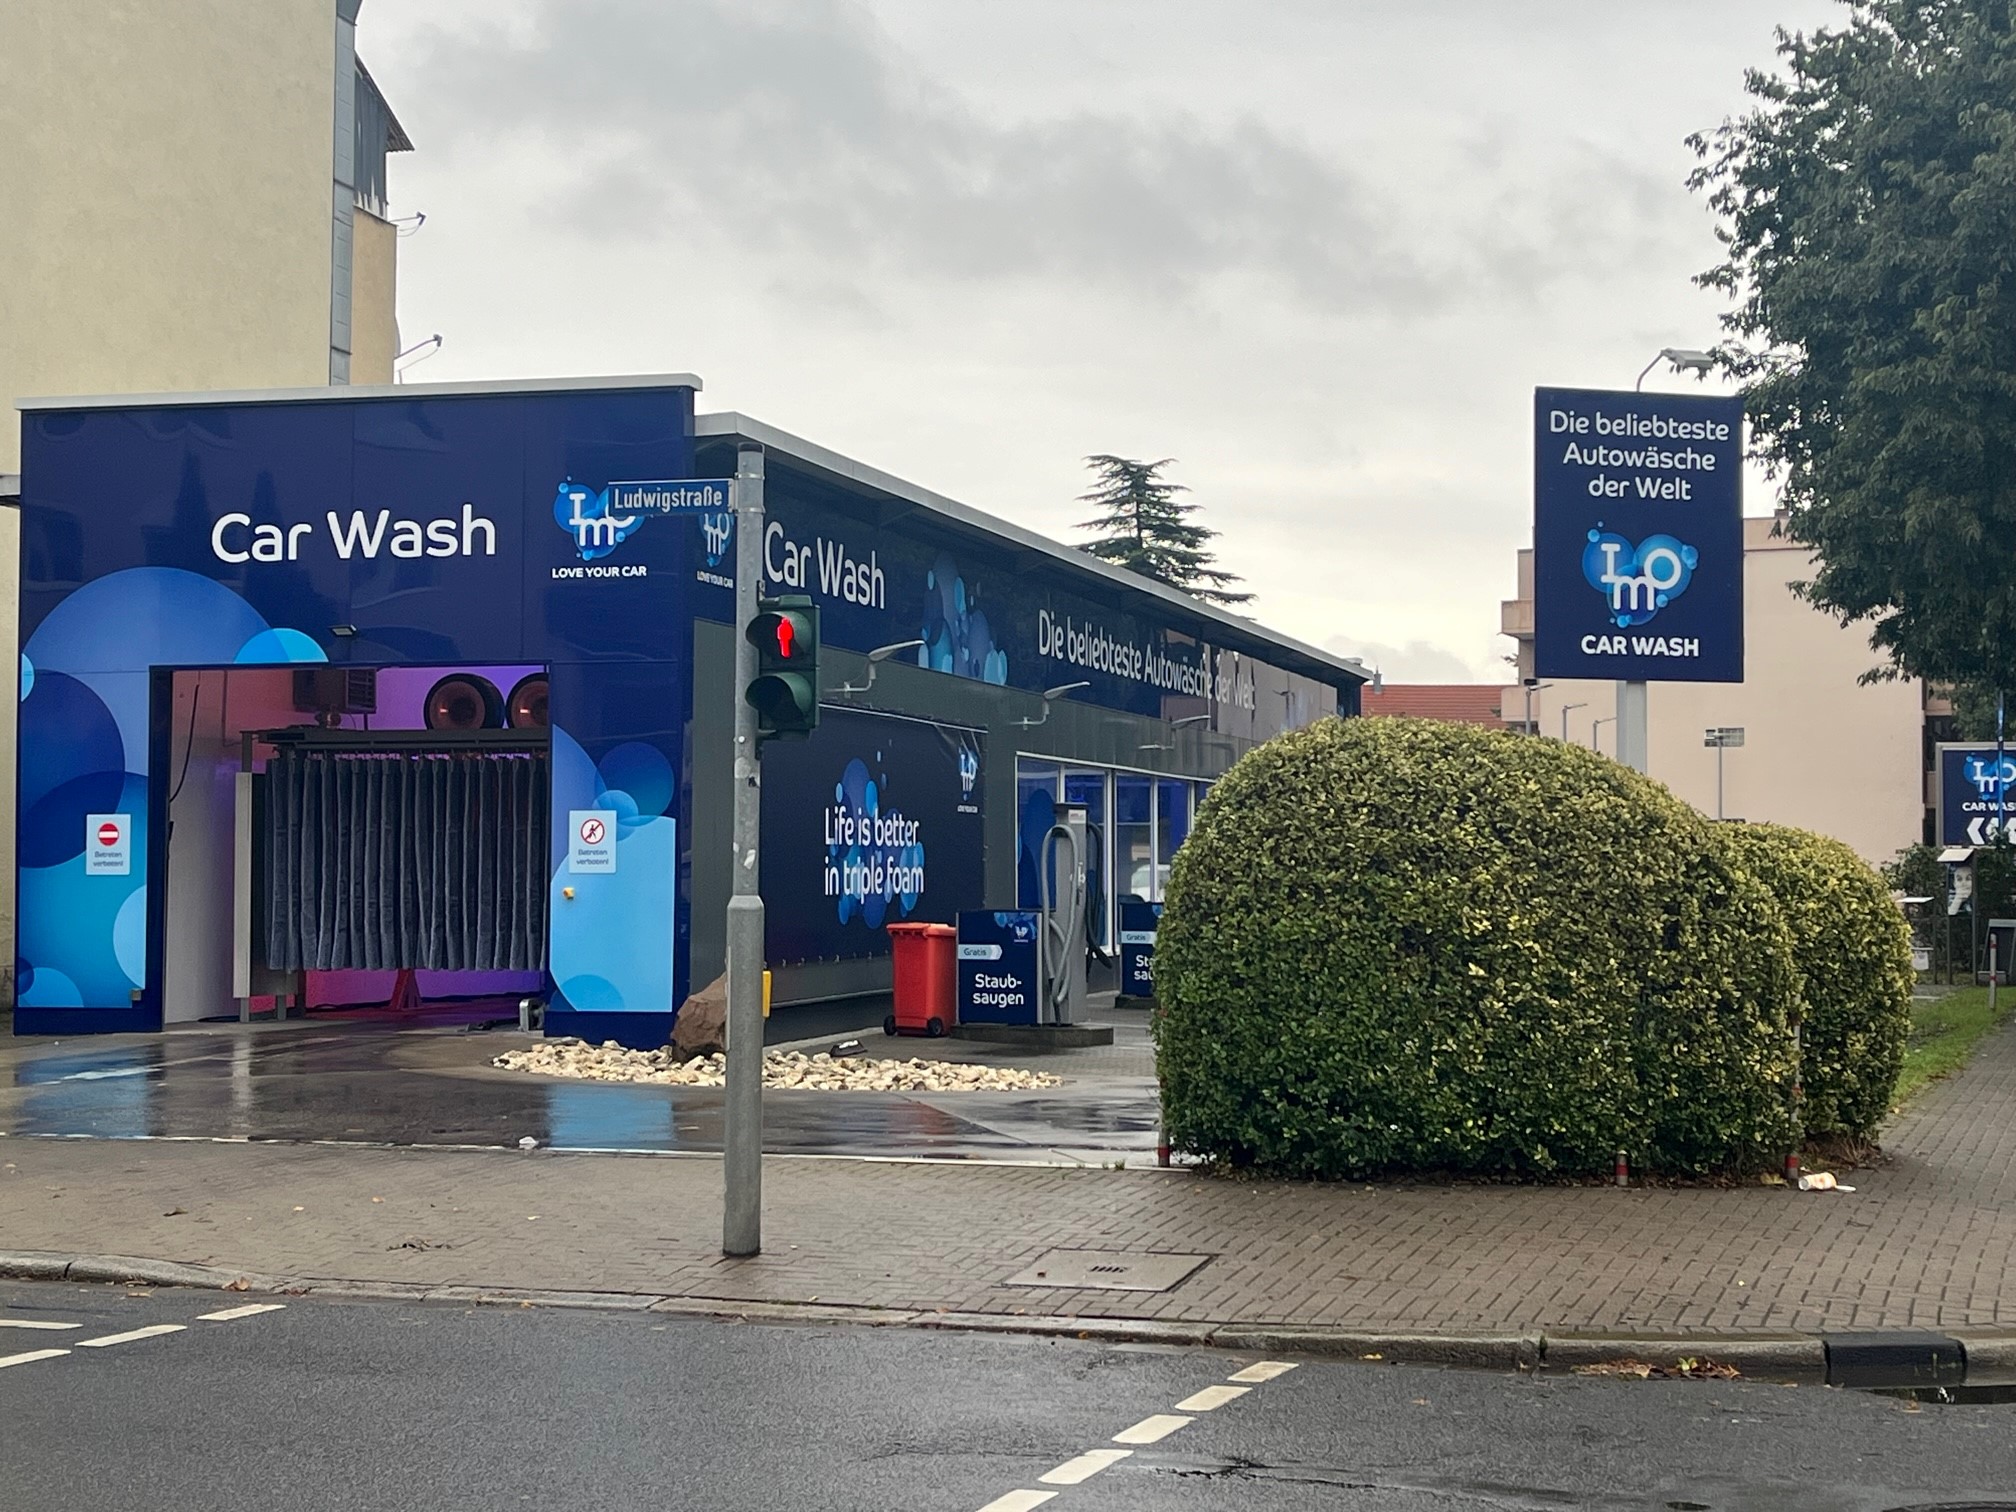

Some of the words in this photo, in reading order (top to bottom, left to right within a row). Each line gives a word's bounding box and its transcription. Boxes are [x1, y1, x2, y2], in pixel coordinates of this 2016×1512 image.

[1550, 410, 1589, 434] Die
[1596, 411, 1729, 441] beliebteste
[1562, 442, 1716, 471] Autowäsche
[614, 485, 723, 512] Ludwigstraße
[1588, 474, 1630, 497] der
[1635, 477, 1691, 500] Welt
[211, 512, 312, 563] Car
[326, 503, 496, 559] Wash
[552, 567, 584, 578] LOVE
[585, 566, 620, 578] YOUR
[621, 565, 647, 577] CAR
[764, 521, 812, 588] Car
[816, 536, 885, 610] Wash
[1038, 608, 1064, 660] Die
[1066, 616, 1142, 681] beliebteste
[1143, 643, 1213, 700] Autowäsche
[1214, 662, 1232, 703] der
[1581, 635, 1627, 655] CAR
[1631, 636, 1699, 657] WASH
[1962, 802, 1986, 811] CAR
[1987, 802, 2016, 811] WAS
[825, 805, 854, 845] Life
[858, 807, 871, 846] is
[874, 807, 920, 847] better
[825, 855, 839, 896] in
[843, 855, 883, 905] triple
[886, 856, 924, 894] foam
[963, 947, 987, 956] Gratis
[975, 973, 1022, 989] Staub-
[973, 992, 1024, 1008] saugen
